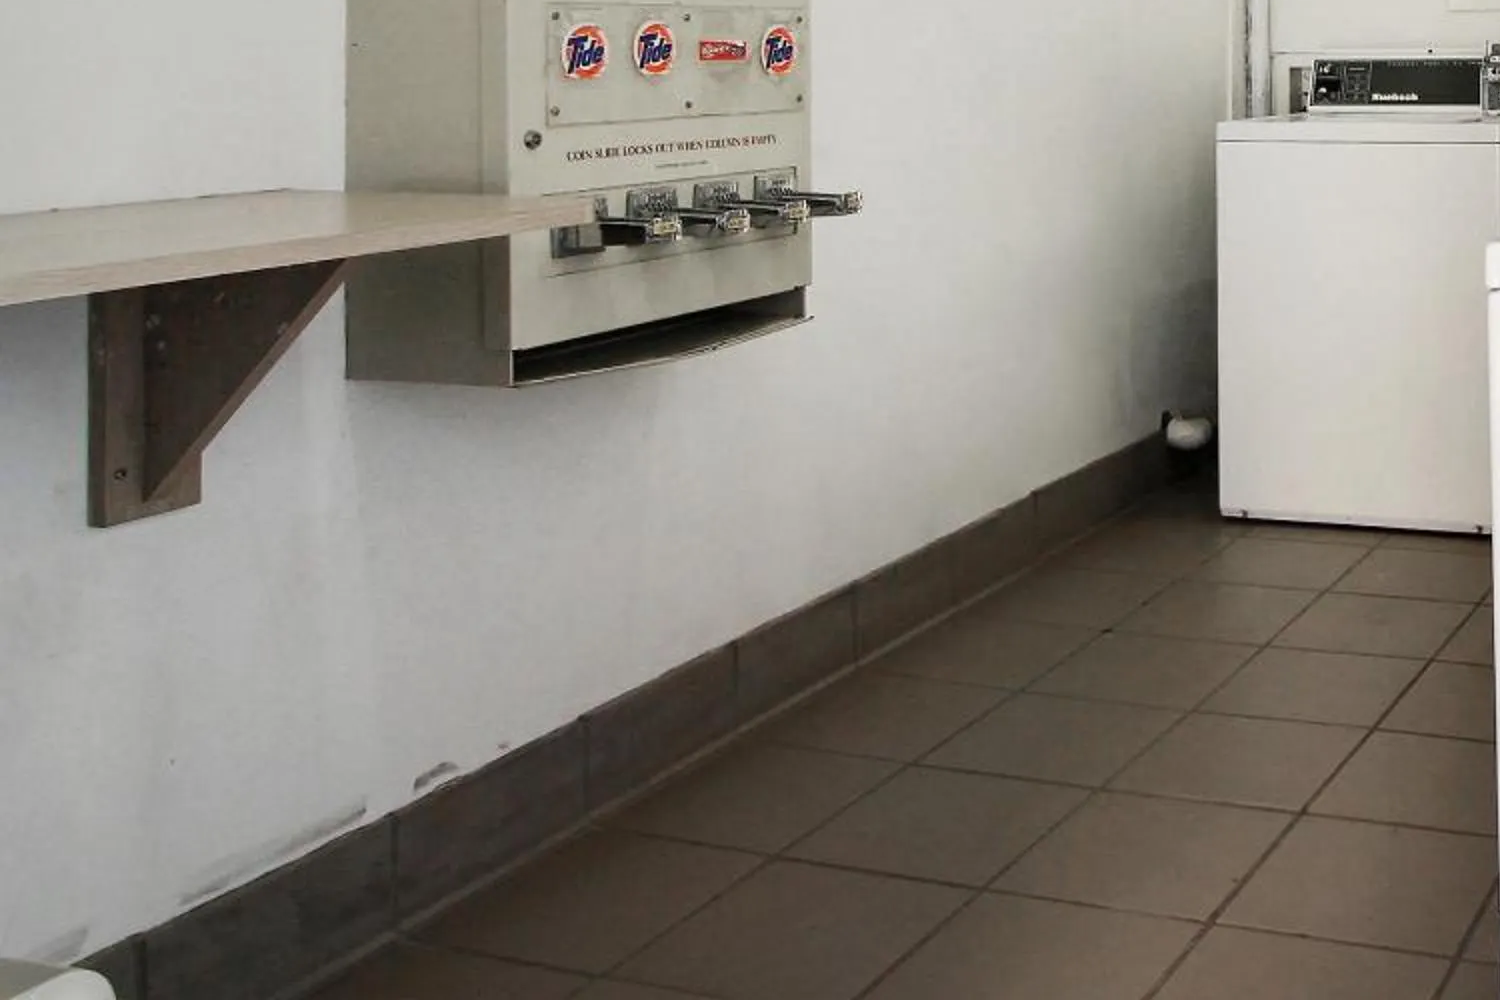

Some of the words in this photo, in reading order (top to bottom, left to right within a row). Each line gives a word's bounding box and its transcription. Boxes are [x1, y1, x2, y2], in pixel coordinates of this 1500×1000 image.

[567, 35, 605, 74] Tide
[639, 32, 673, 69] Tide
[765, 36, 794, 69] Tide
[655, 142, 675, 153] OUT
